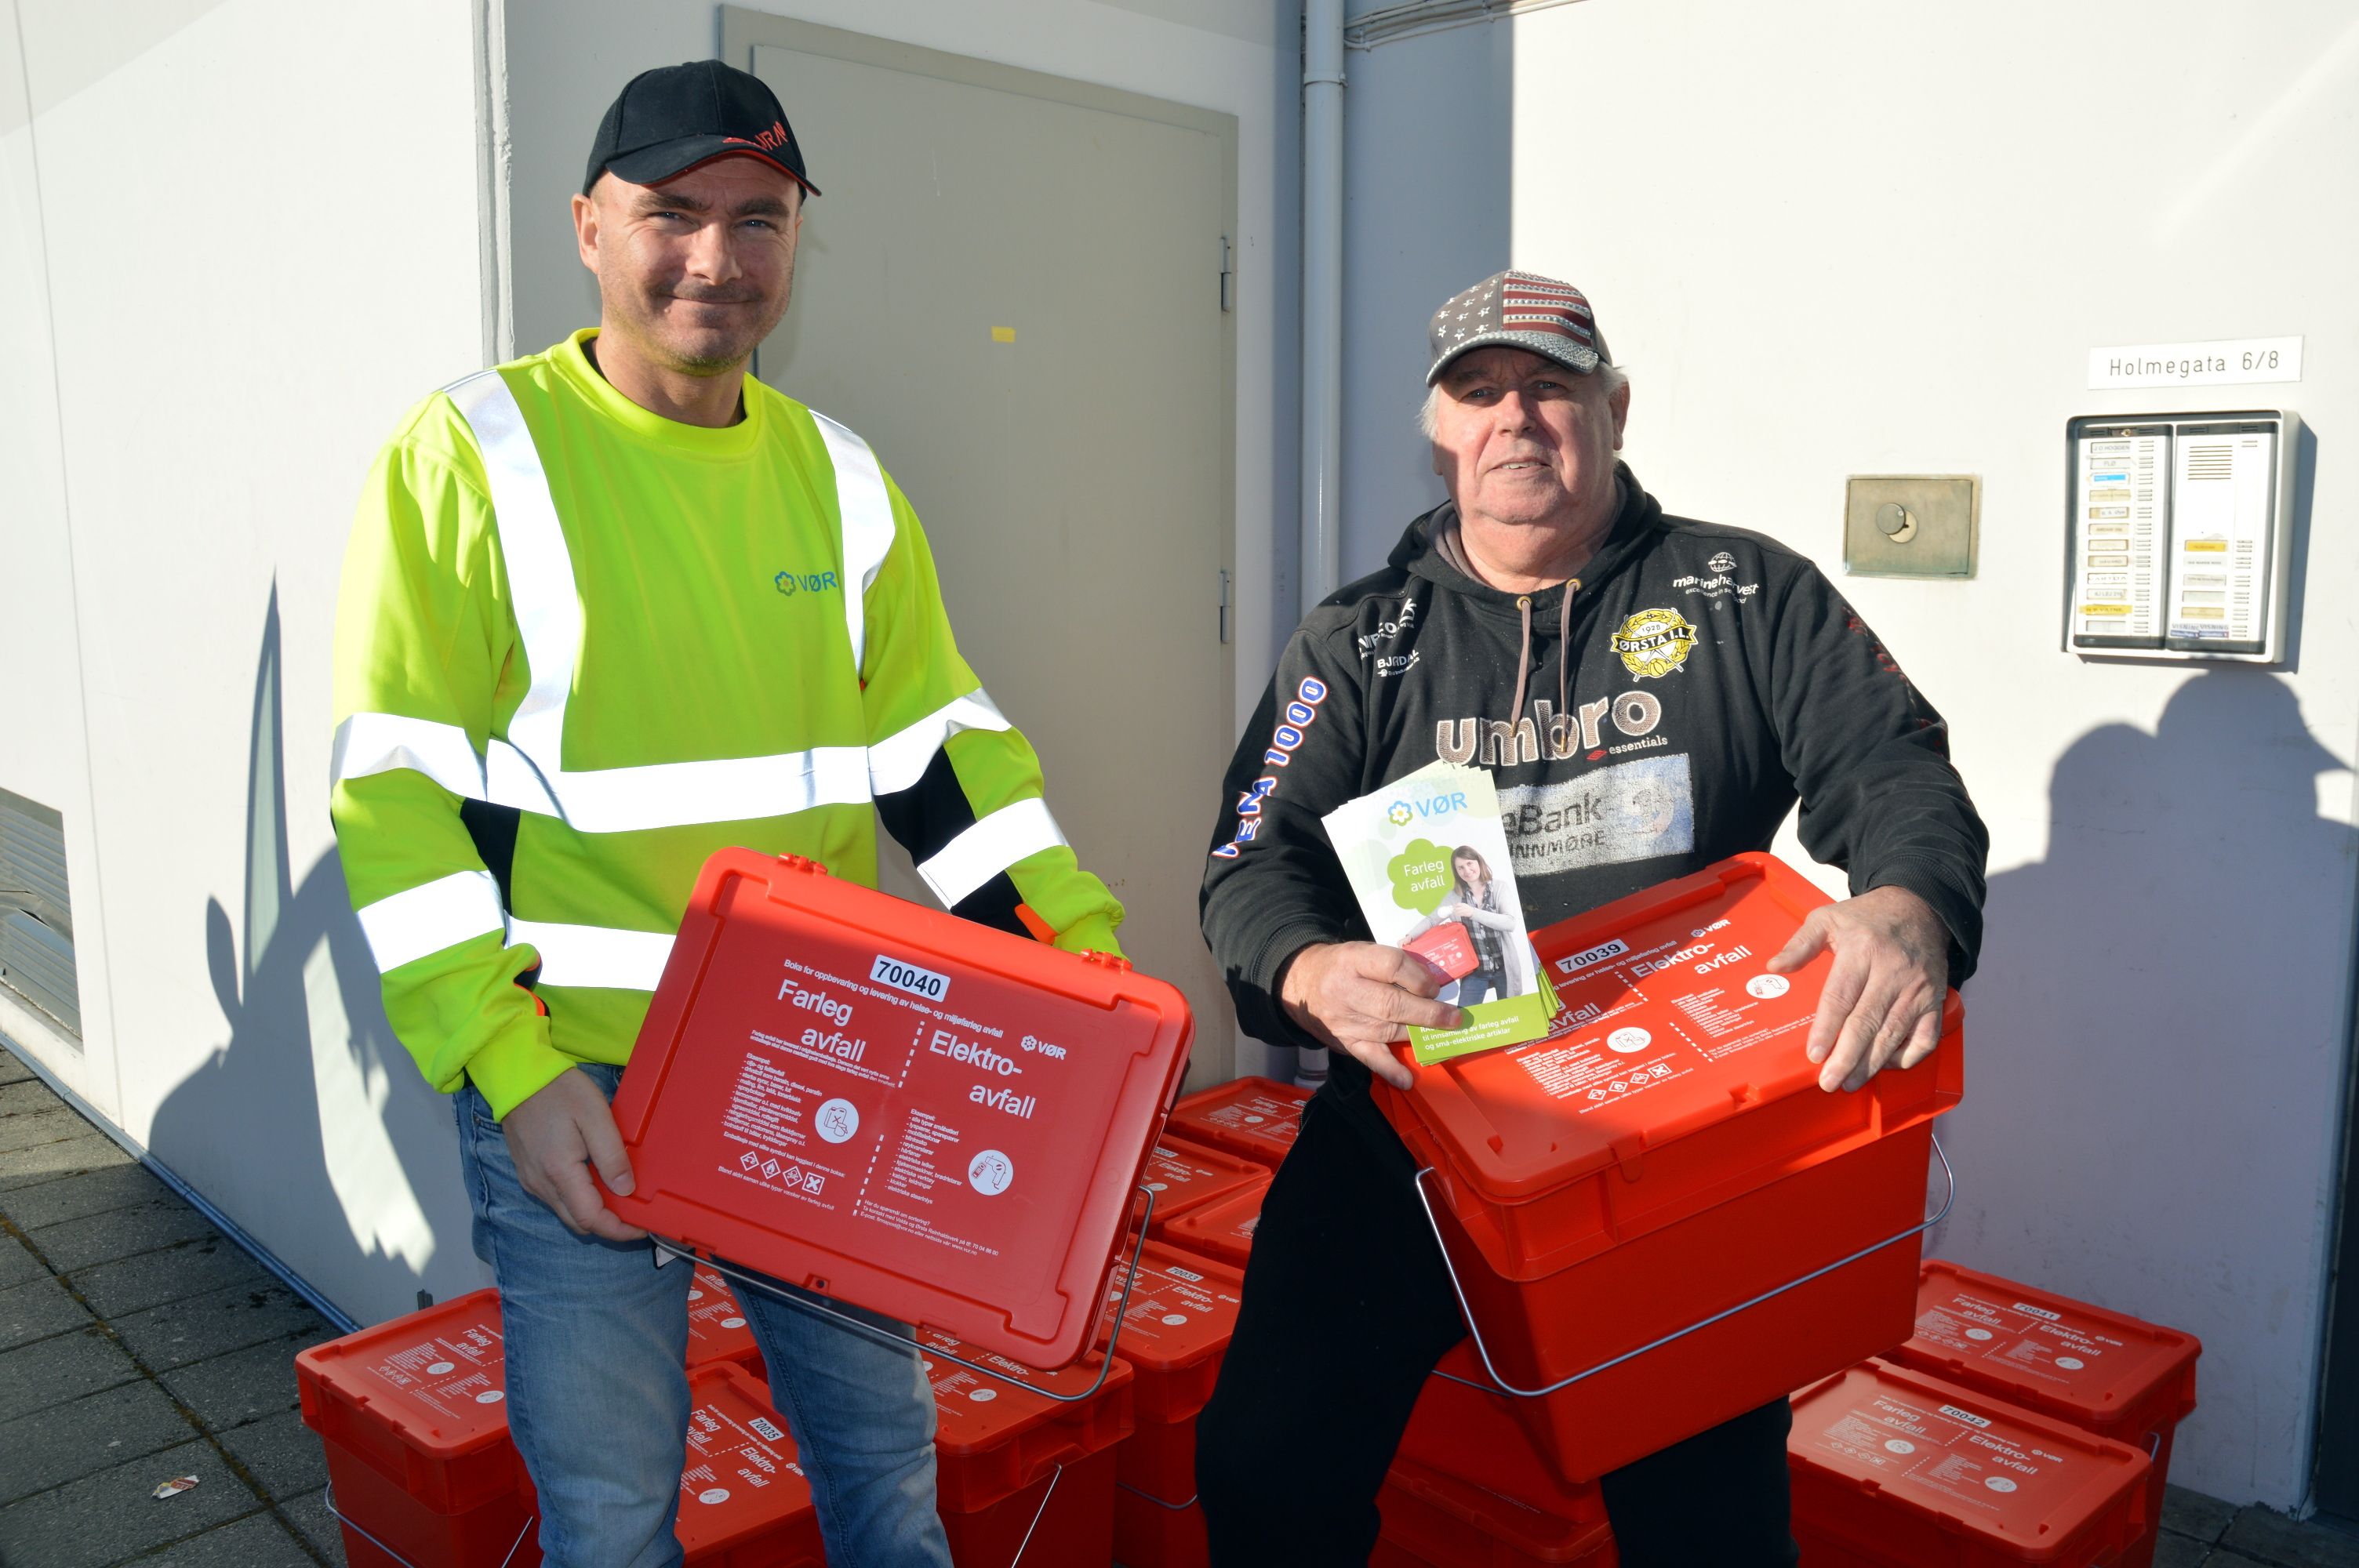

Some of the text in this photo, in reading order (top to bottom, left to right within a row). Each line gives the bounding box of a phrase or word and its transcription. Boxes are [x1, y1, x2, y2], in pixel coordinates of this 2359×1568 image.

[2110, 350, 2279, 378] Holmegata 6/8
[796, 571, 838, 592] VØR
[1619, 627, 1690, 652] ØRSTA I.L.
[1263, 676, 1328, 768] 1000
[1436, 690, 1662, 767] umbro
[1608, 735, 1669, 755] essentials
[1416, 791, 1468, 818] VØR
[1508, 829, 1608, 861] NNMØRE
[1404, 859, 1445, 877] Farleg
[1411, 876, 1445, 893] avfall
[1705, 918, 1731, 934] VØR
[1558, 975, 1587, 989] levering
[1594, 964, 1616, 974] helse-
[1623, 947, 1660, 963] miljøfarleg
[1657, 940, 1678, 949] avfall
[1561, 942, 1622, 971] 70039
[1631, 942, 1715, 978] Elektro-
[1694, 945, 1753, 975] avfall
[877, 960, 941, 996] 70040
[777, 978, 854, 1028] Farleg
[783, 958, 1004, 1039] Boks for oppbevaring og levering av helse- og miljøfarleg avfall
[1547, 1003, 1601, 1032] avfall
[1430, 1028, 1469, 1042] innsamling
[1478, 1020, 1499, 1032] farleg
[1500, 1015, 1520, 1026] avfall
[1435, 1033, 1486, 1048] små-elektriske
[1486, 1027, 1511, 1039] artiklar
[801, 1028, 867, 1062] avfall
[929, 1029, 1023, 1076] Elektro-
[1037, 1040, 1067, 1061] VØR
[968, 1081, 1036, 1120] avfall
[1170, 1268, 1200, 1281] 70033
[1172, 1287, 1213, 1303] Elektro-
[1180, 1300, 1214, 1313] avfall
[1952, 1297, 1997, 1316] Farleg
[1962, 1308, 2002, 1325] avfall
[2016, 1303, 2055, 1319] 70041
[462, 1327, 493, 1347] Farleg
[926, 1331, 961, 1347] arleg
[2039, 1324, 2095, 1345] Elektro-
[2105, 1337, 2124, 1347] VØR
[456, 1341, 485, 1357] avfall
[2060, 1340, 2102, 1357] avfall
[987, 1355, 1029, 1375] Elektro-
[691, 1409, 722, 1432] Farleg
[1873, 1400, 1921, 1422] Farleg
[1943, 1406, 1986, 1427] 70042
[687, 1425, 713, 1444] avfall
[751, 1418, 780, 1439] 70035
[1884, 1414, 1927, 1434] avfall
[1968, 1435, 2031, 1462] Elektro-
[2043, 1454, 2063, 1464] VØR
[740, 1446, 776, 1474] Elektro-
[1992, 1454, 2038, 1475] avfall
[737, 1468, 771, 1488] avfall
